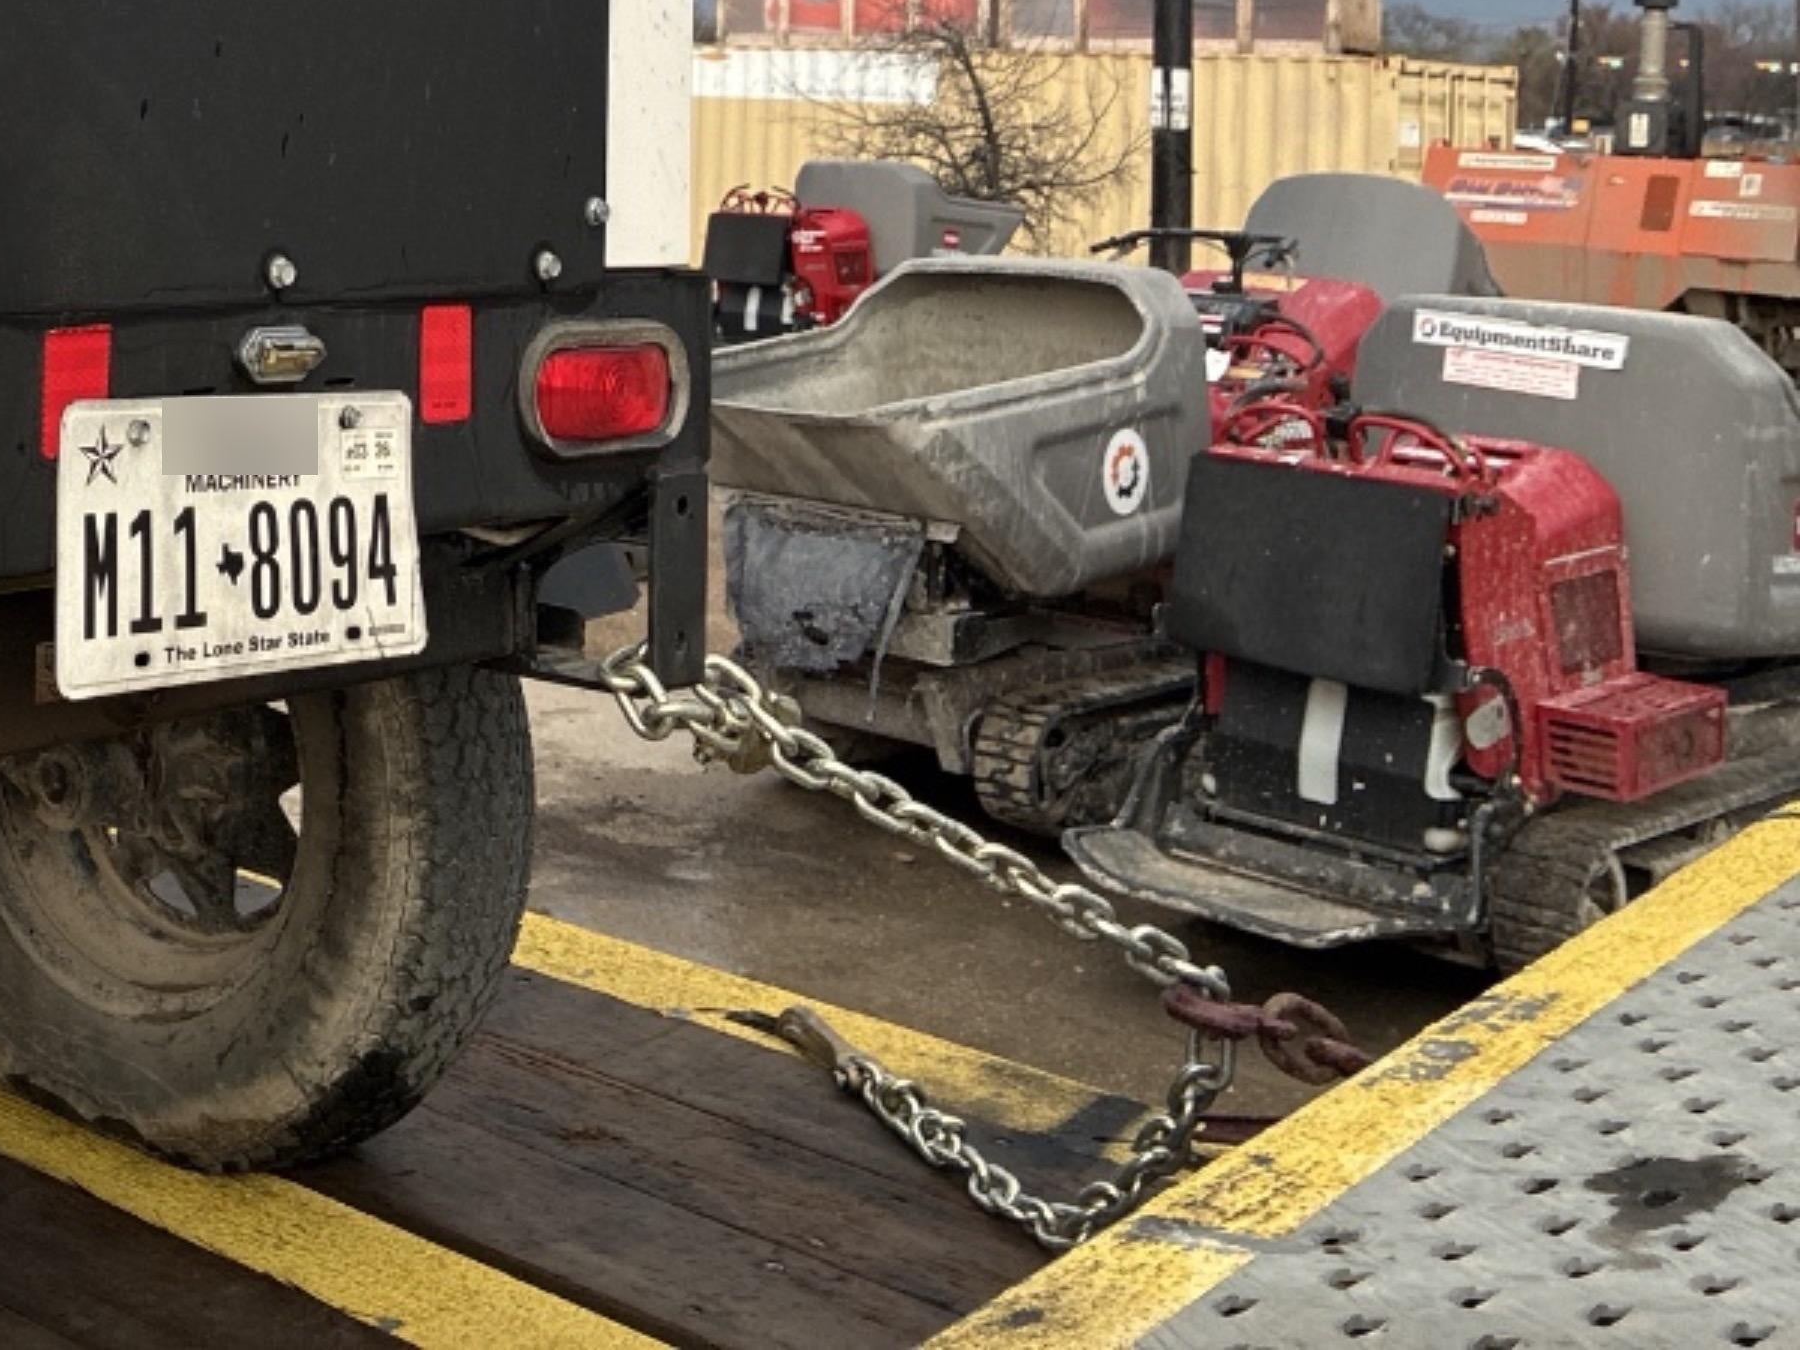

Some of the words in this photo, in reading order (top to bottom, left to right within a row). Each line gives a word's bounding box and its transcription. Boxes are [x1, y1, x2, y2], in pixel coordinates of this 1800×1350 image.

[1439, 321, 1615, 361] EquipmentShare
[185, 474, 301, 493] MACHINERY
[164, 647, 196, 664] The
[203, 641, 244, 658] Lone
[248, 635, 282, 653] Star
[288, 629, 331, 647] State
